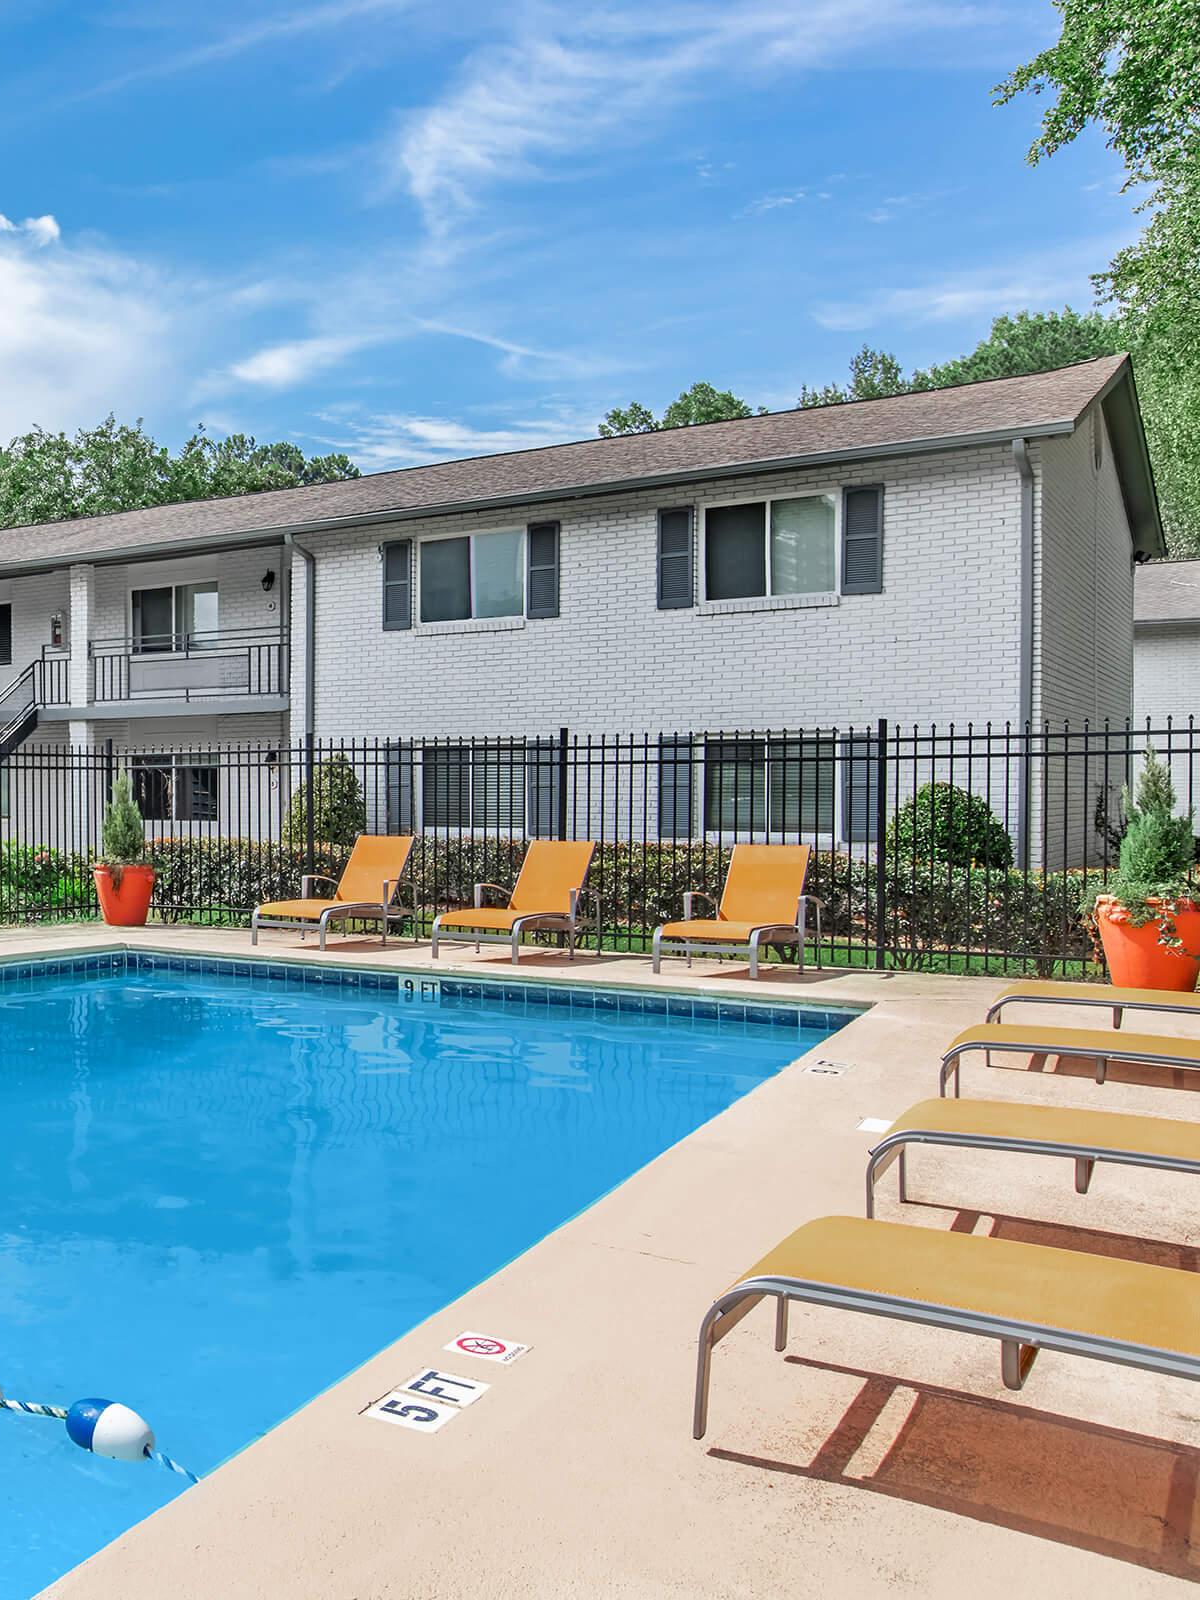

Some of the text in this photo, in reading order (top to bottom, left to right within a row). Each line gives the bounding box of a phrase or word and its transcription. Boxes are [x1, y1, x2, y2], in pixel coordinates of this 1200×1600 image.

[405, 979, 438, 992] 9 FT
[379, 1371, 476, 1423] 5 FT
